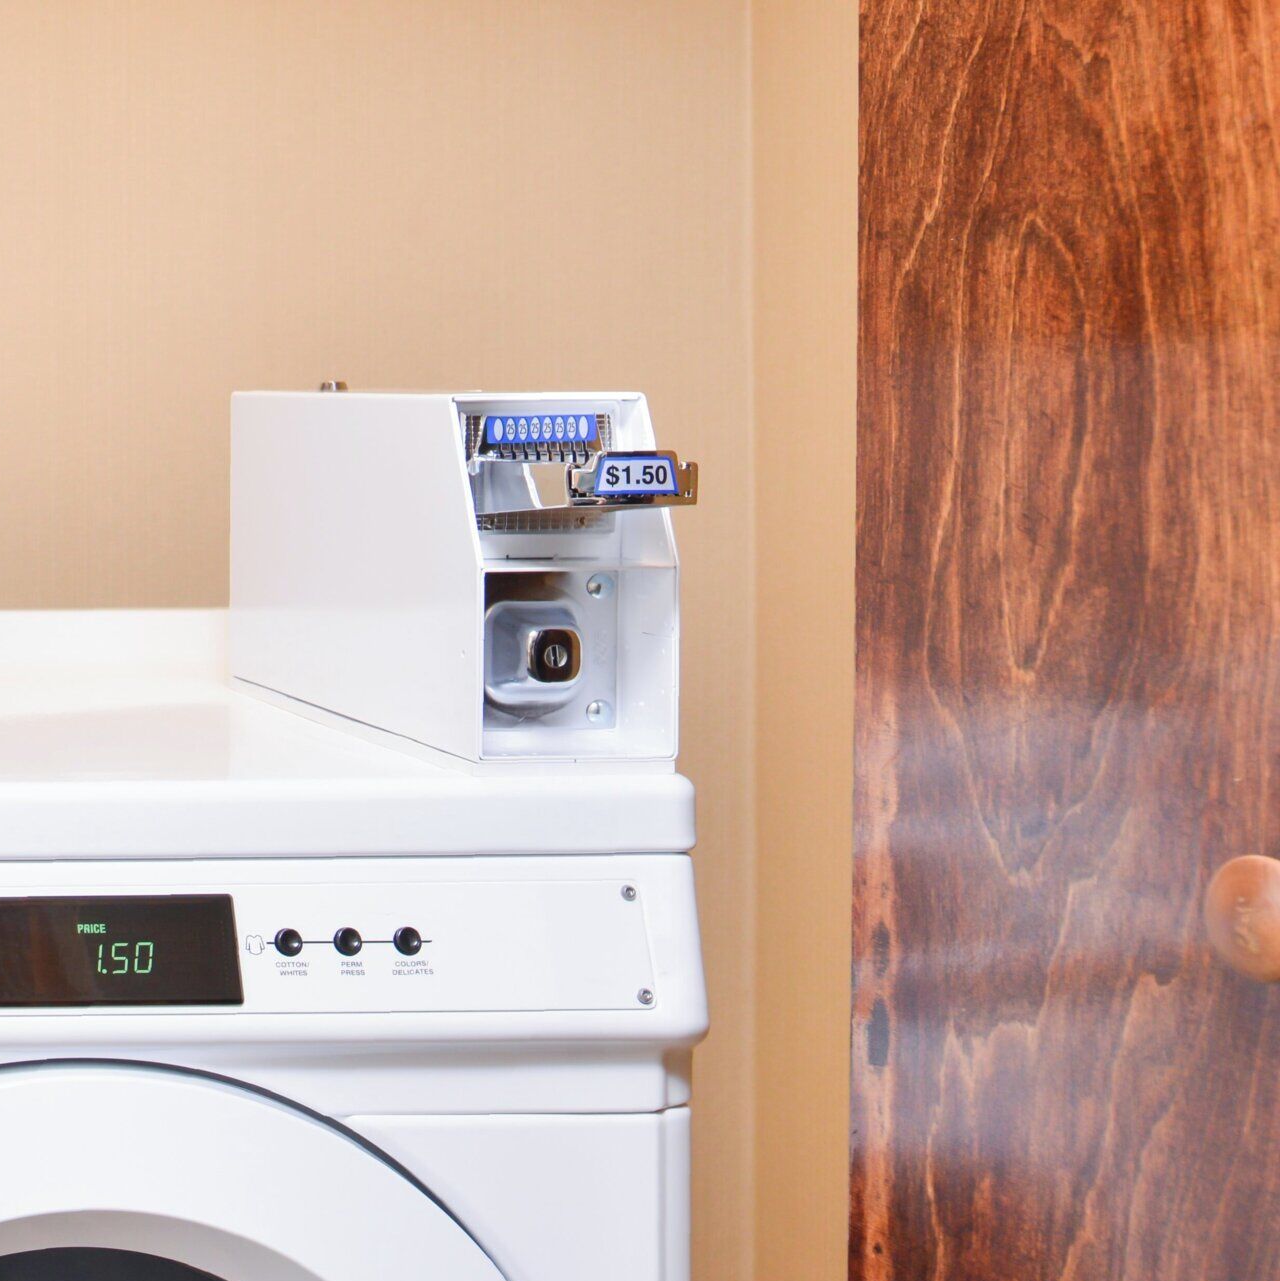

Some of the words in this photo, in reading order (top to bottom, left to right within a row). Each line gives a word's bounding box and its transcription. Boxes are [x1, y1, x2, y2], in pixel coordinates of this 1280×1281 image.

[506, 423, 516, 435] 25
[519, 423, 528, 435] 25
[531, 422, 540, 434] 25
[543, 422, 553, 434] 25
[556, 421, 565, 433] 25
[568, 421, 577, 432] 25
[605, 464, 668, 487] $1.50
[77, 923, 106, 934] PRICE
[97, 941, 154, 974] 1.50
[392, 968, 434, 976] DELICATES
